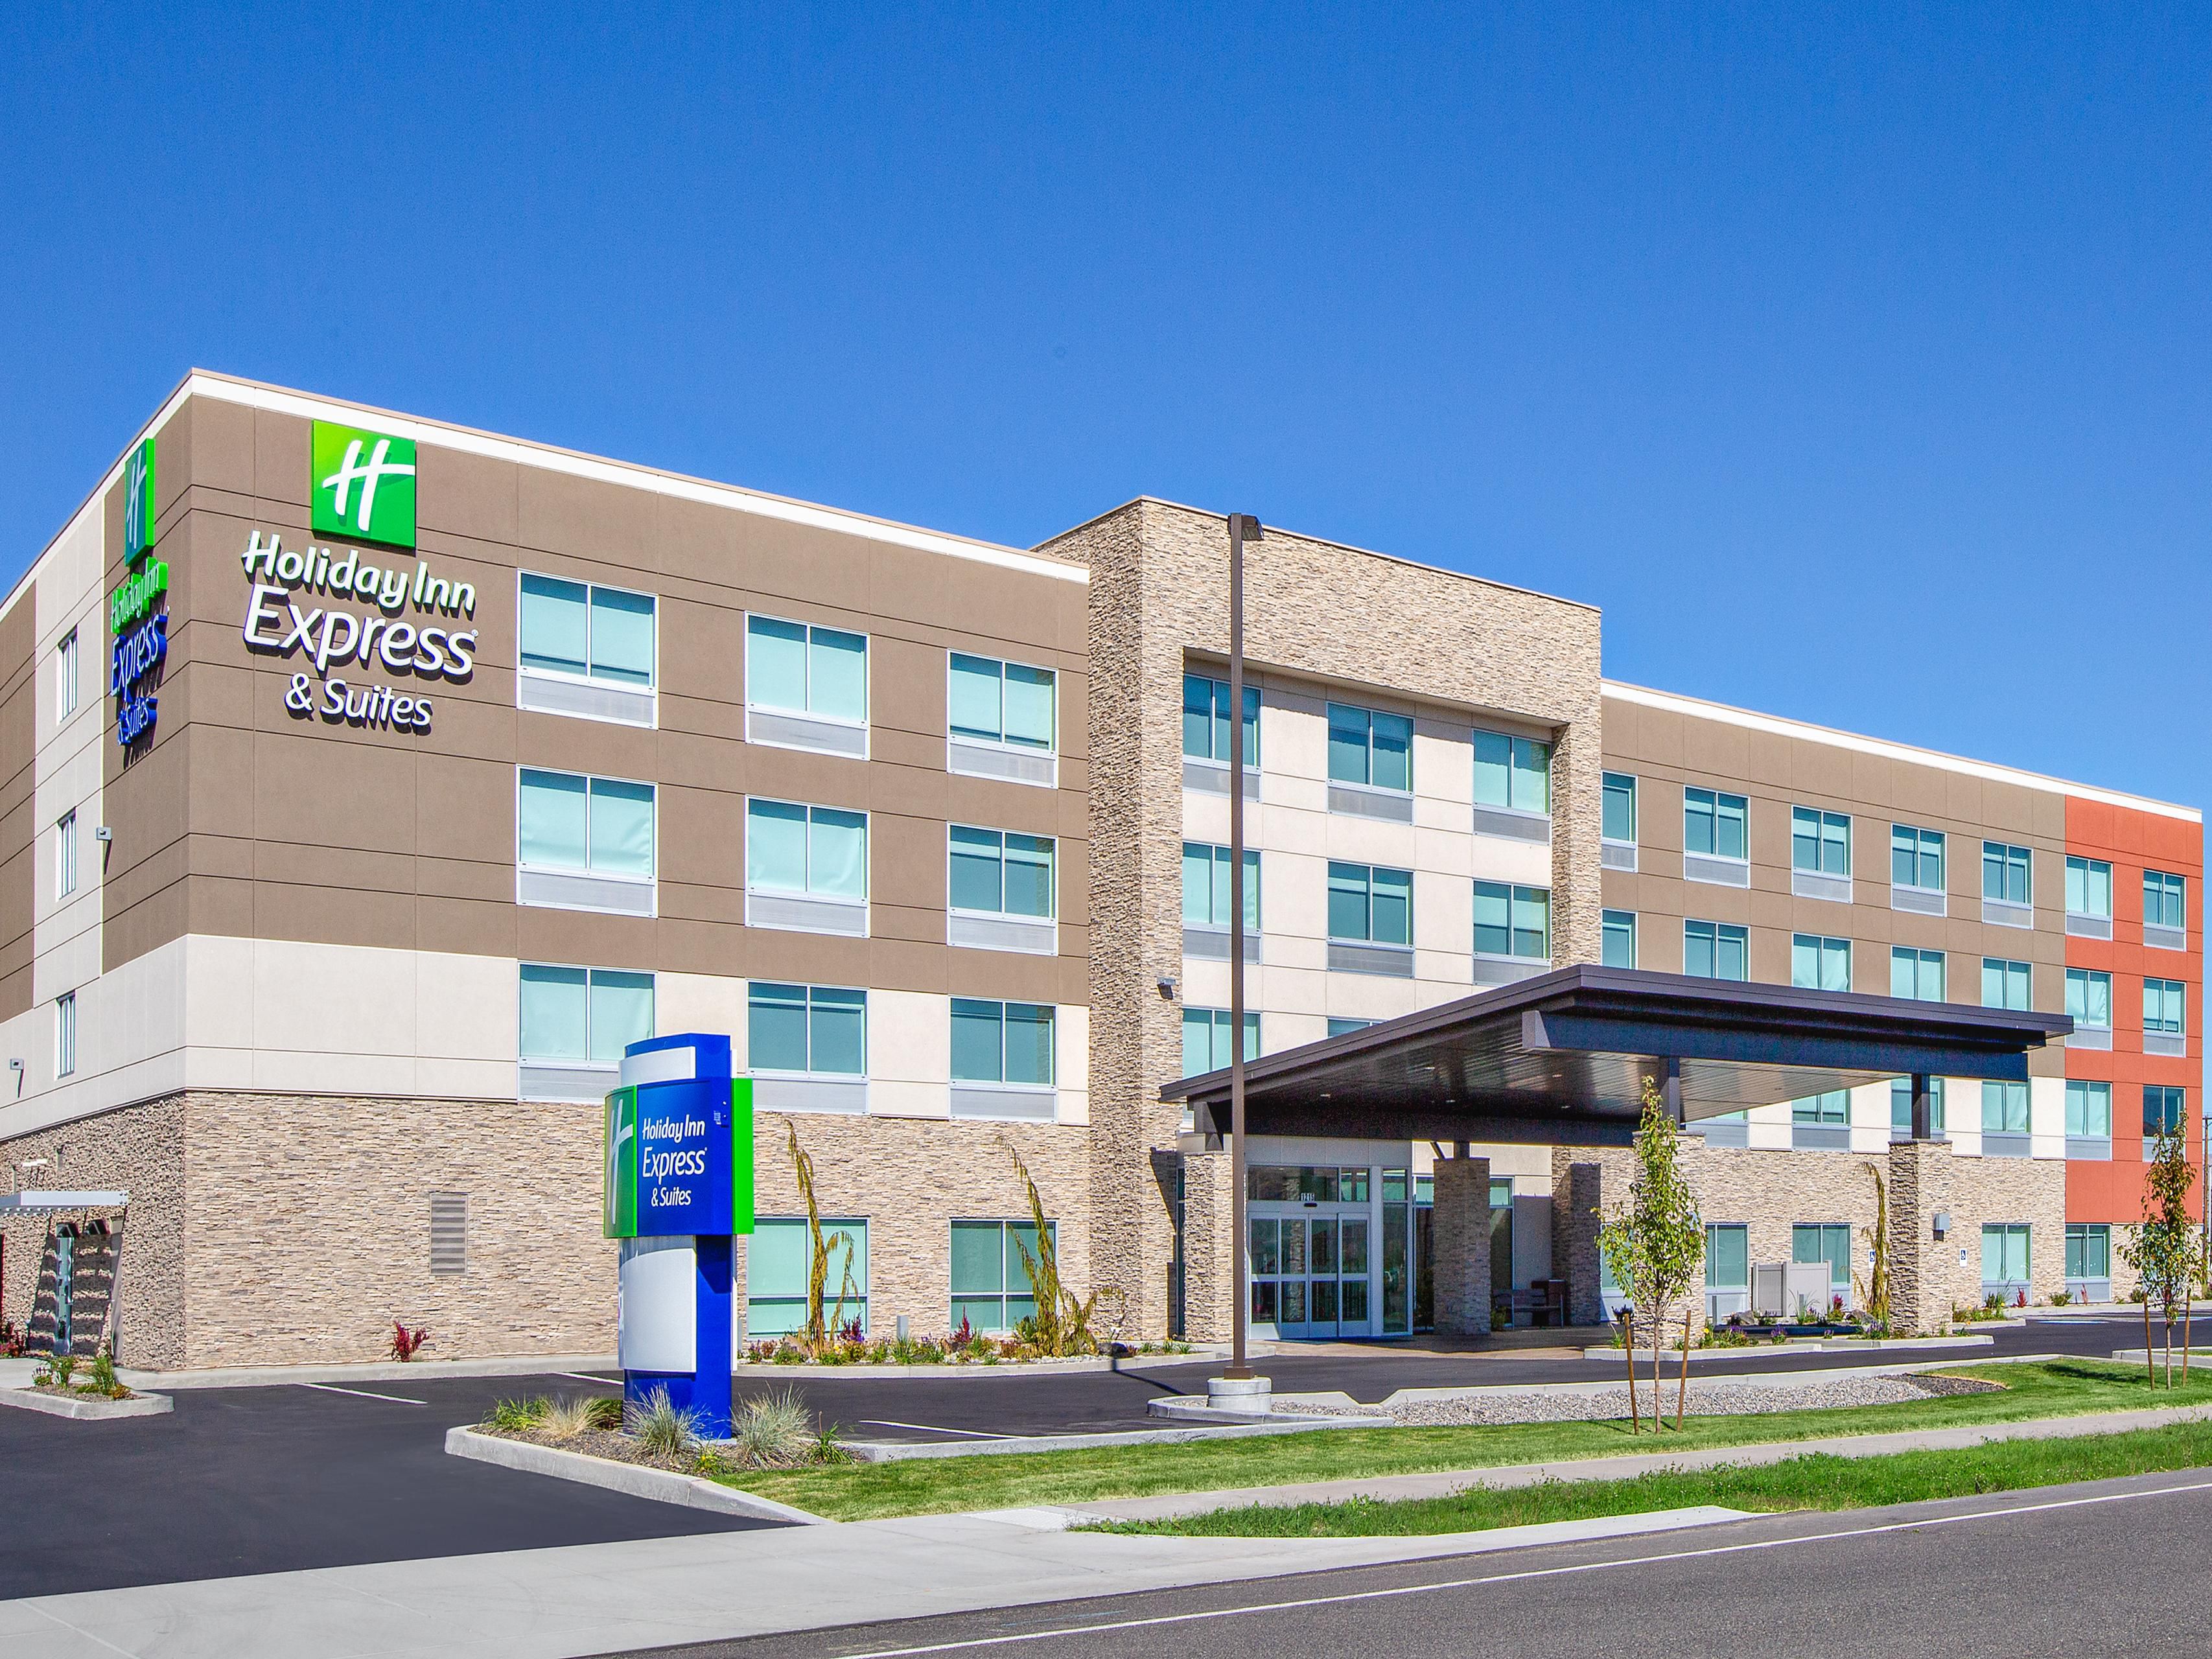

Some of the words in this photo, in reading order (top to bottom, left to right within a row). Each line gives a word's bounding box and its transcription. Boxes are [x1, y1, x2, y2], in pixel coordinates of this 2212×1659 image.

[111, 573, 145, 633] Holiday
[145, 557, 161, 599] Inn
[240, 529, 409, 609] Holiday
[412, 560, 476, 611] Inn
[243, 583, 477, 675] Express
[111, 614, 161, 702] Express
[126, 698, 151, 740] Suites
[285, 672, 313, 712] &
[320, 678, 433, 726] Suites
[642, 1116, 684, 1143] Holiday
[684, 1114, 705, 1137] Inn
[642, 1146, 706, 1185] Express
[651, 1187, 659, 1207] &
[660, 1187, 692, 1206] Suites
